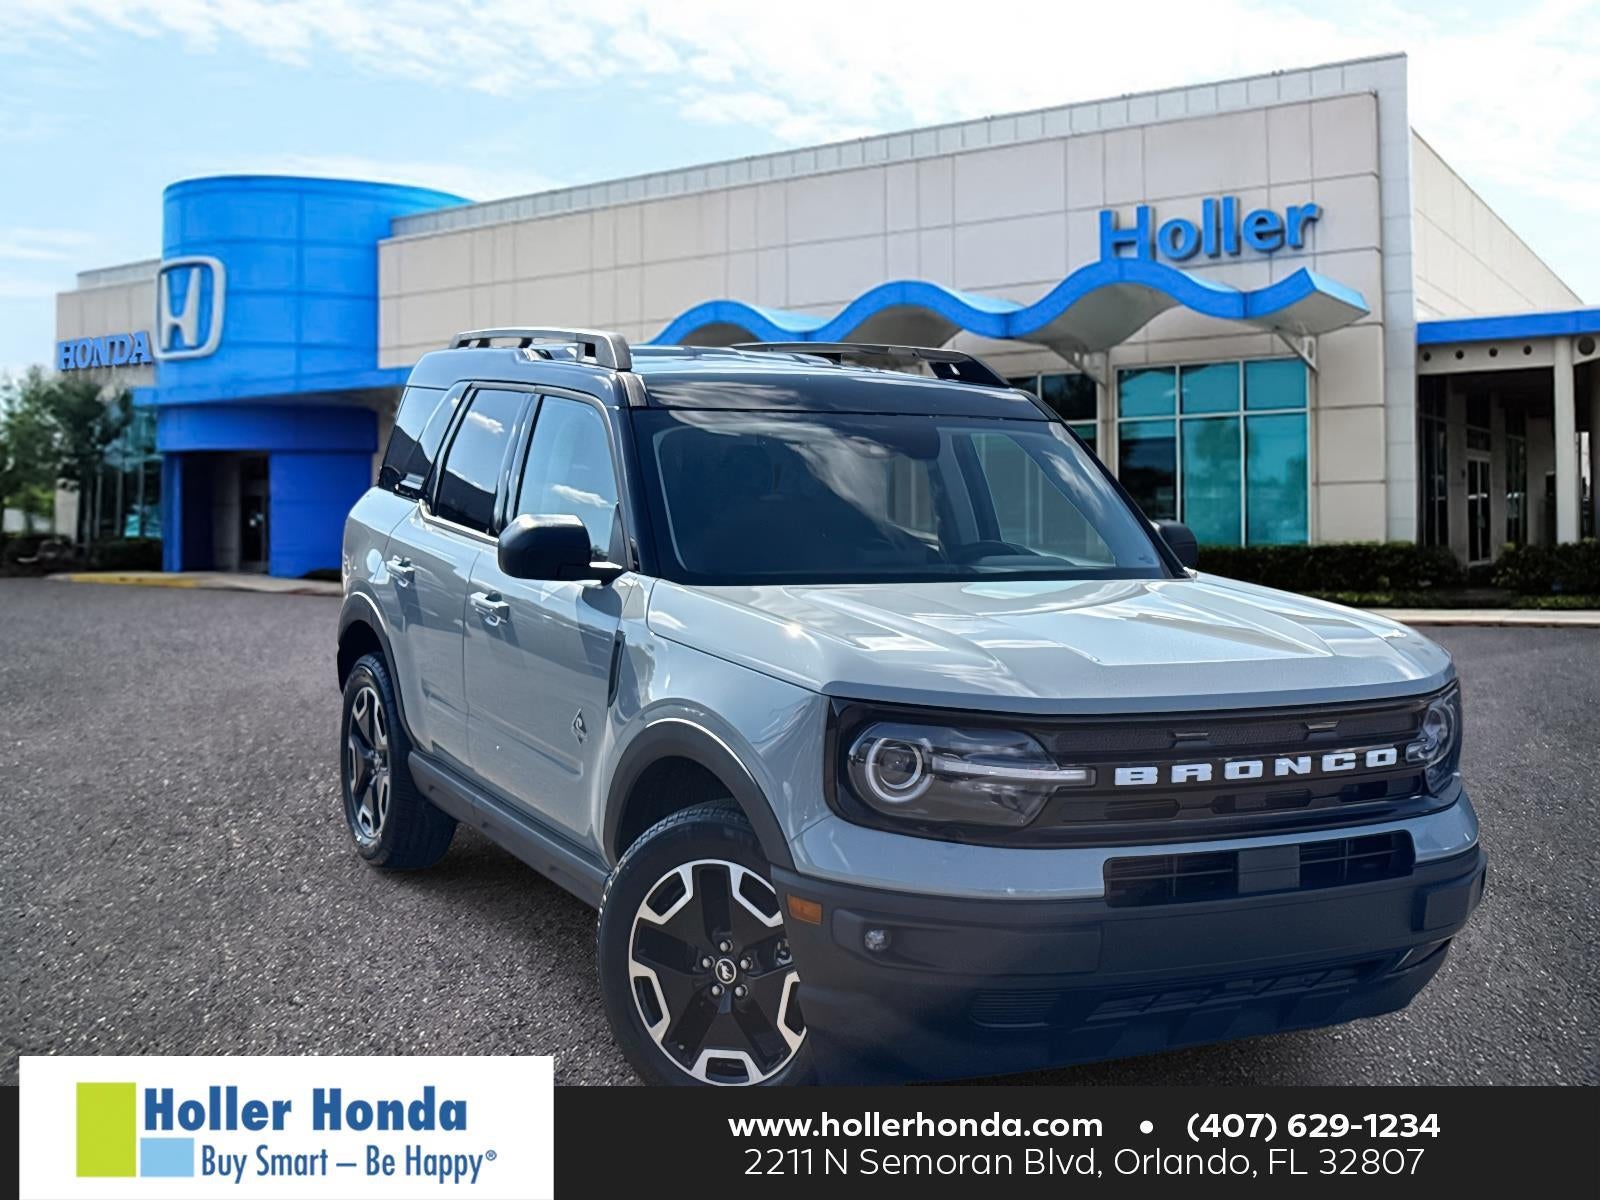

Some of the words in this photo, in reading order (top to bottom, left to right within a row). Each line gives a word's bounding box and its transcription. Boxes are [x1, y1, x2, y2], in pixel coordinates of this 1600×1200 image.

[1100, 195, 1322, 262] Holler
[57, 331, 153, 370] HONDA
[1114, 747, 1398, 786] BRONCO
